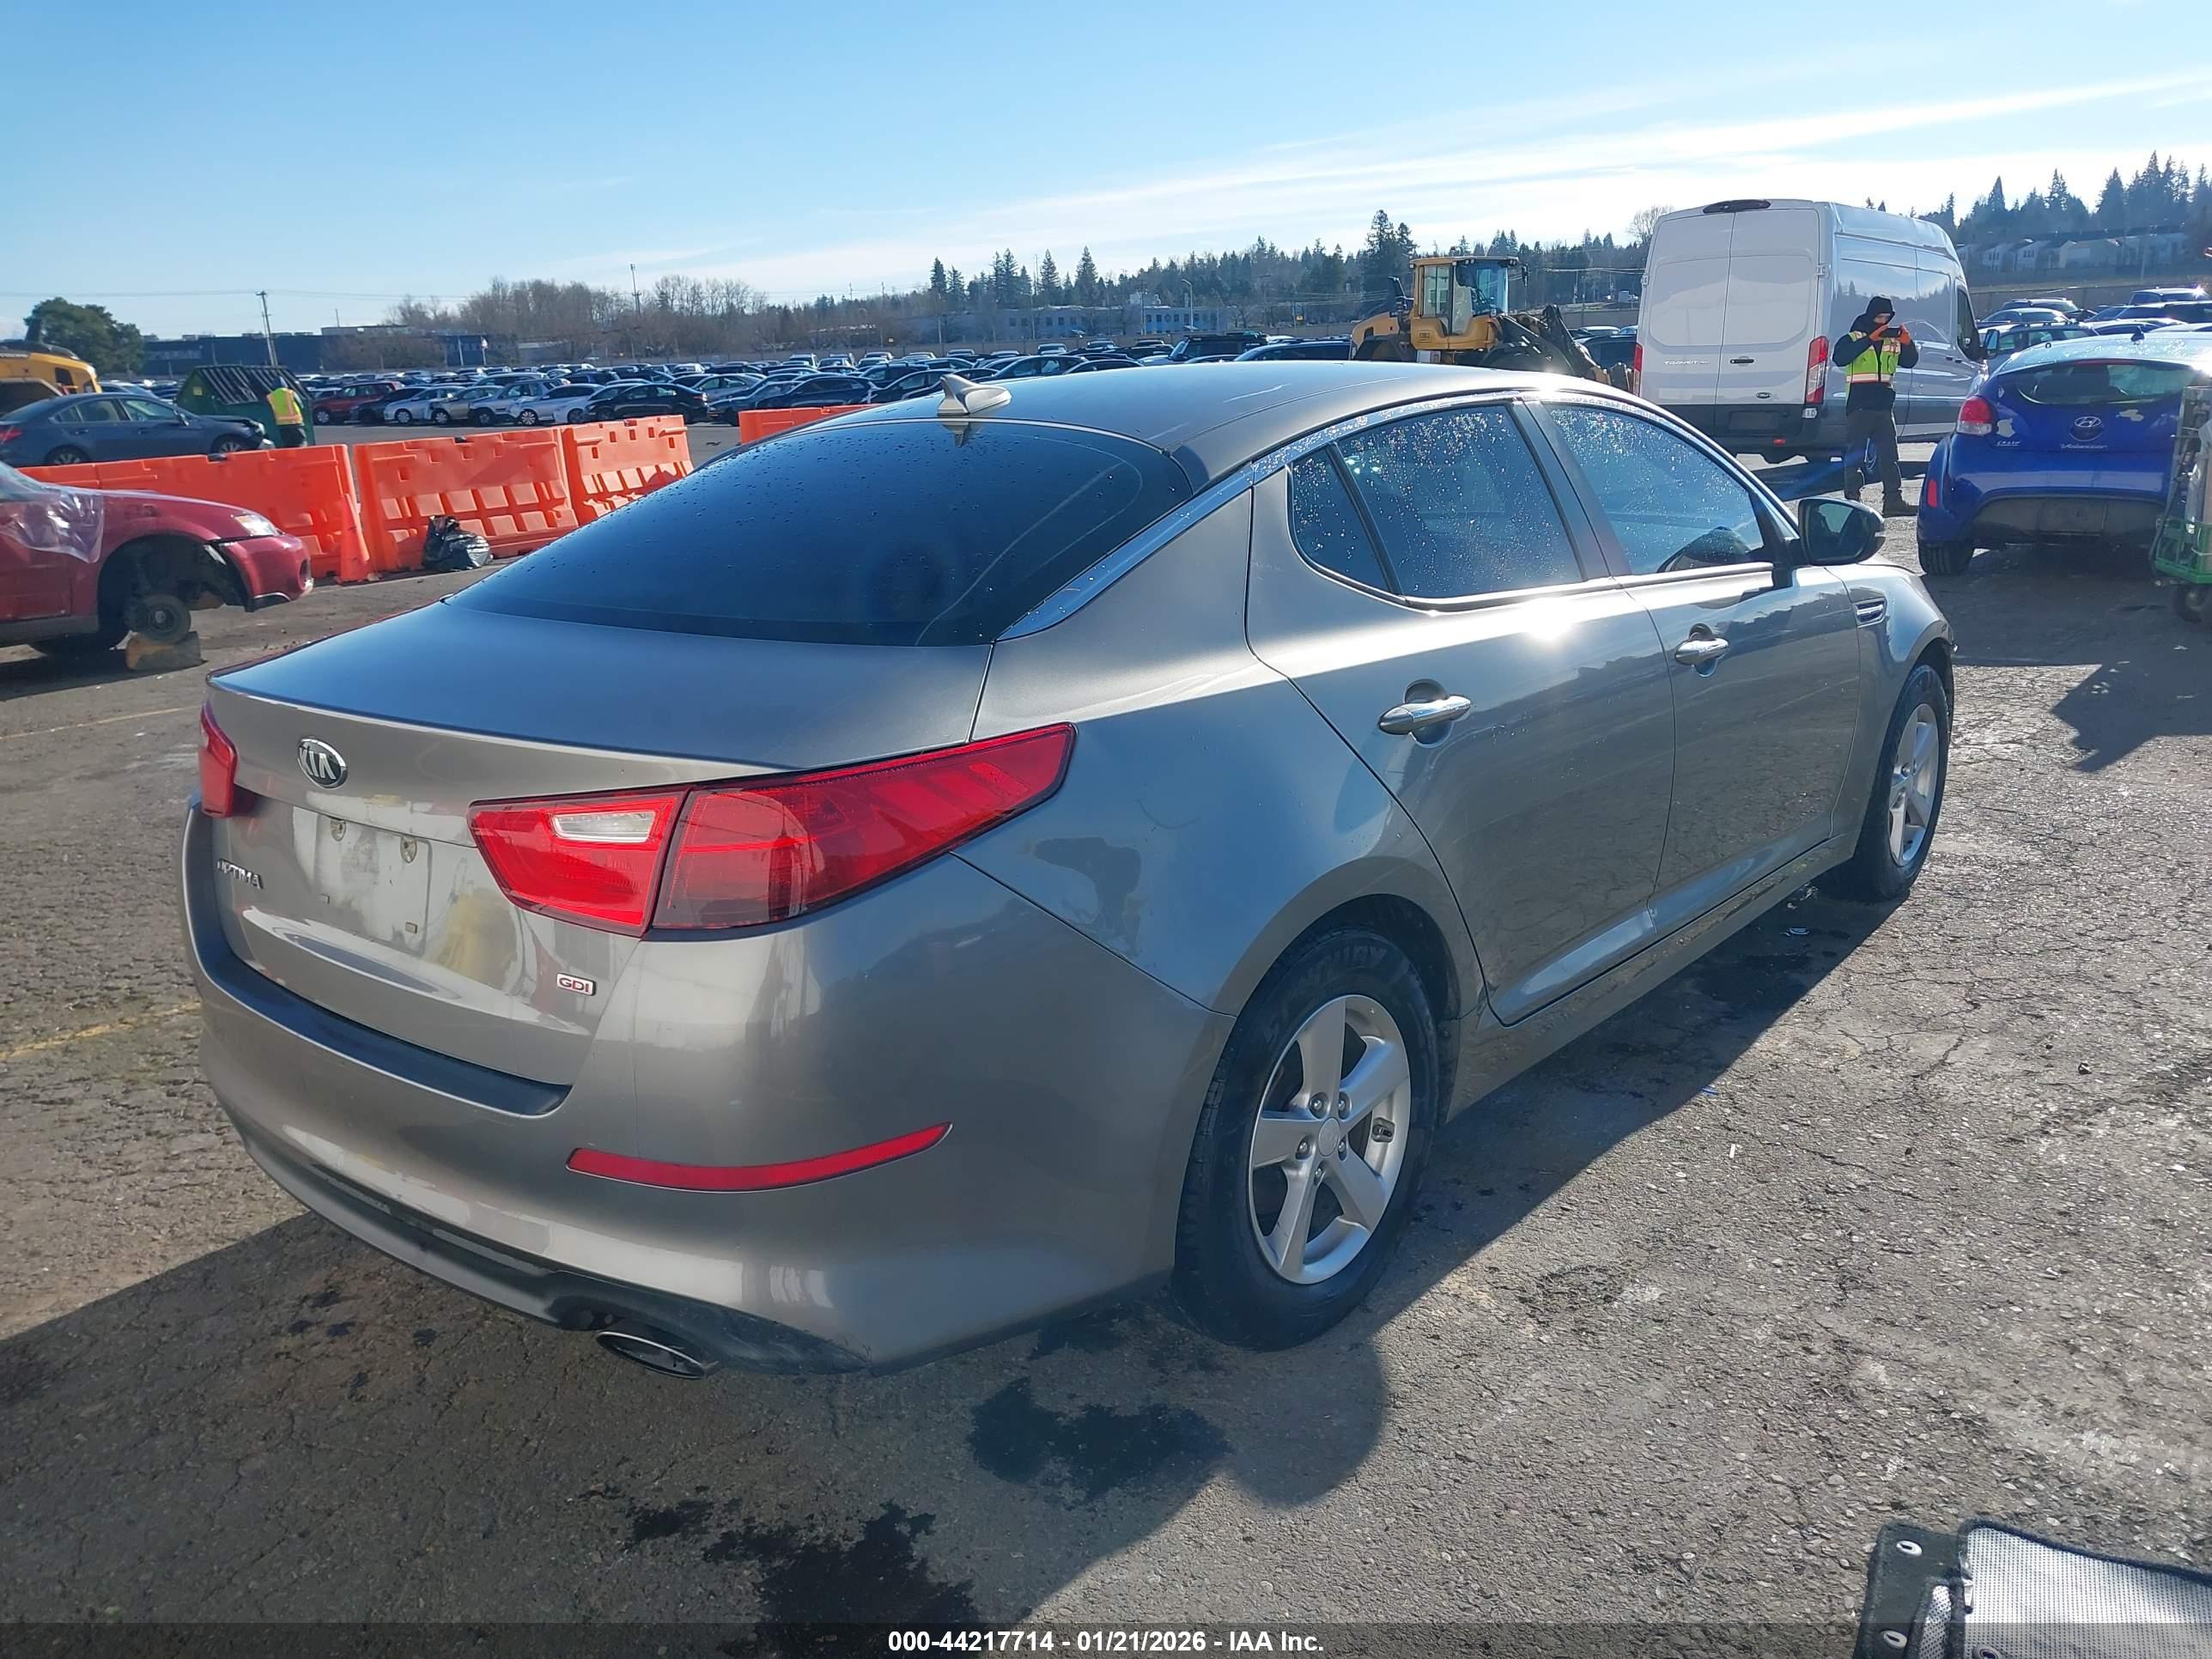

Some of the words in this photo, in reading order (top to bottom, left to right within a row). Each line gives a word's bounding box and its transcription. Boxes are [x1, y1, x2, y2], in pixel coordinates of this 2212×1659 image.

[299, 743, 337, 780] KIA
[216, 860, 261, 890] OPTIMA
[558, 977, 590, 993] GDI
